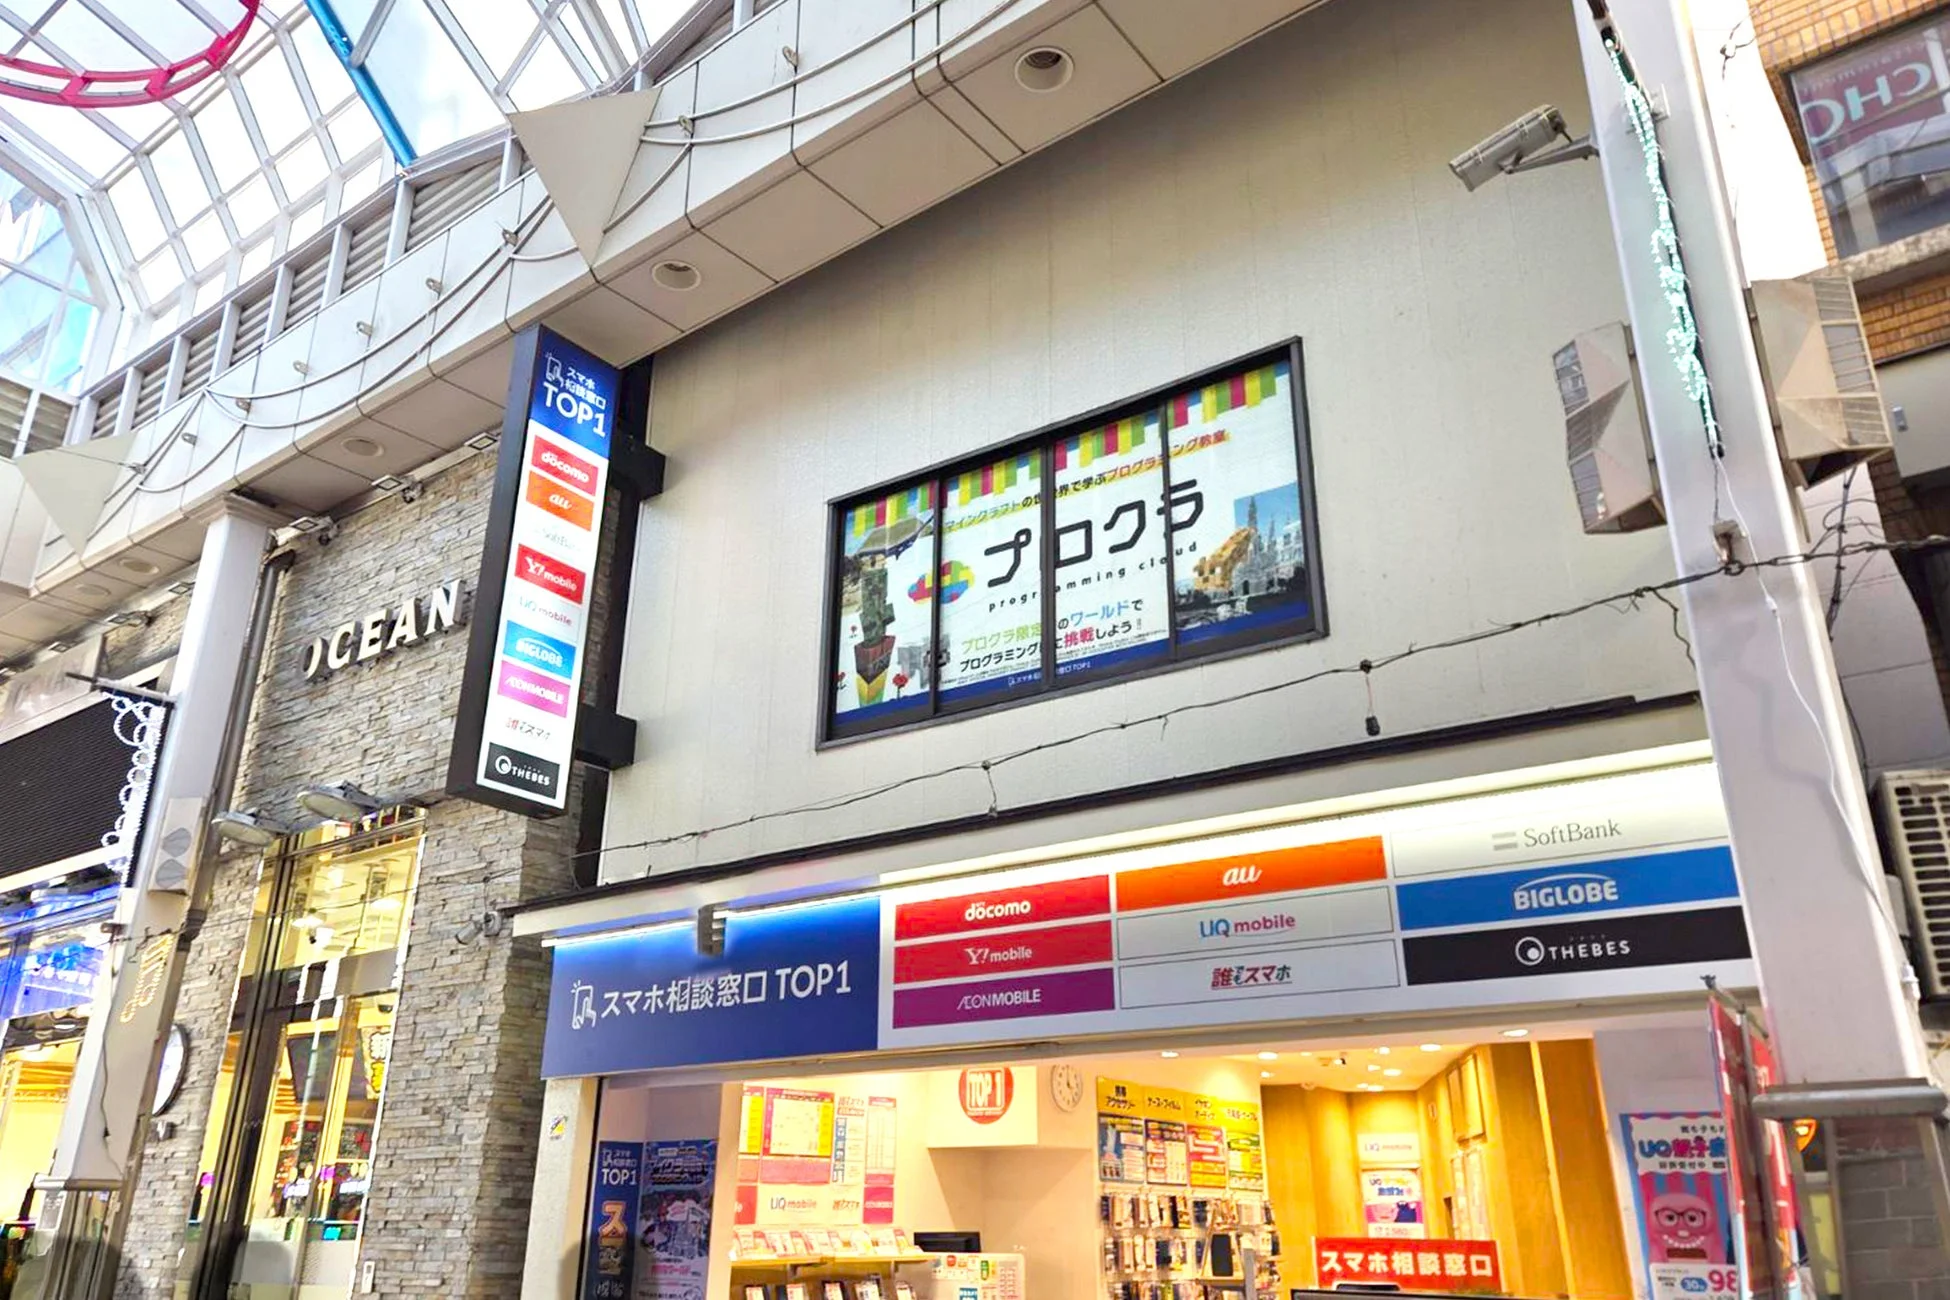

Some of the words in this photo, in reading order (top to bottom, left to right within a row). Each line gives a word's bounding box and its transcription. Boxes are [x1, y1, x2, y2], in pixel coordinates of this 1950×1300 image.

[566, 366, 596, 390] スマホ
[565, 378, 607, 411] 相談窓口
[543, 381, 606, 438] TOP1
[541, 452, 590, 483] docomo
[549, 493, 573, 510] au
[984, 478, 1204, 589] プロクラ
[988, 565, 1127, 614] programming
[1138, 541, 1198, 572] cloud
[538, 606, 573, 628] mobile
[303, 579, 467, 681] OCEAN
[515, 638, 564, 669] BIGLOBE
[511, 766, 551, 786] THEBES
[1523, 818, 1622, 849] SoftBank
[1222, 865, 1262, 887] au
[1513, 879, 1619, 911] BIGLOBE
[964, 900, 1031, 921] docomo
[1199, 918, 1231, 938] UQ
[1233, 914, 1297, 934] mobile
[1549, 939, 1631, 961] THEBES
[1211, 964, 1292, 988] 誰でもスマホ
[600, 970, 767, 1019] スマホ相談窓口
[775, 959, 852, 1000] TOP1
[601, 1168, 638, 1186] TOP1
[770, 1196, 786, 1211] UQ
[1320, 1251, 1493, 1277] スマホ相談窓口
